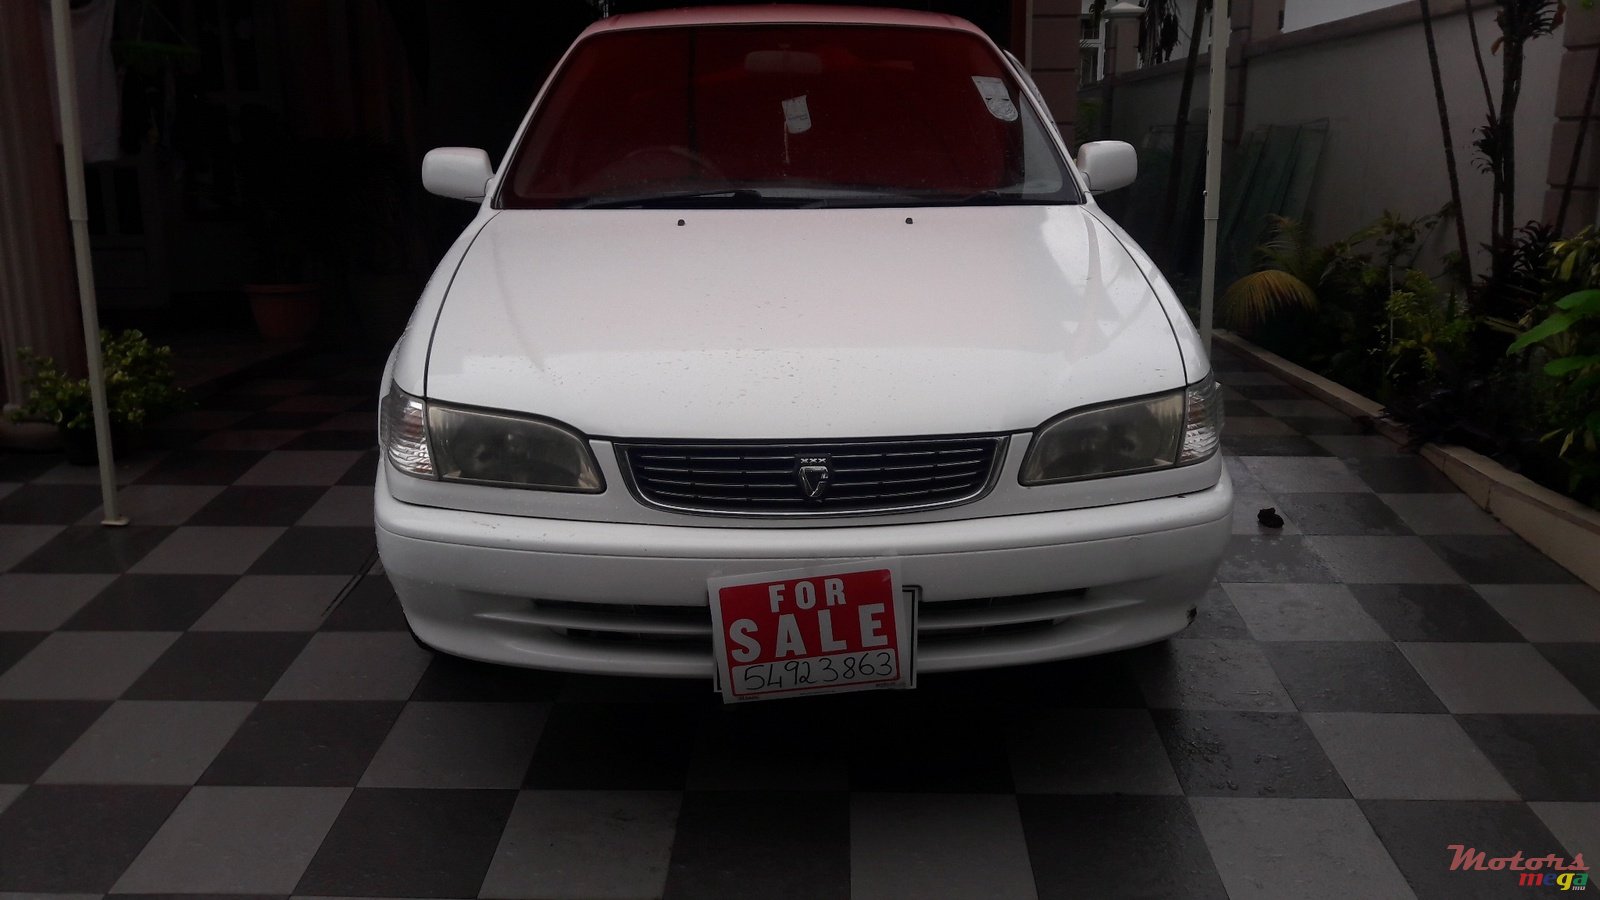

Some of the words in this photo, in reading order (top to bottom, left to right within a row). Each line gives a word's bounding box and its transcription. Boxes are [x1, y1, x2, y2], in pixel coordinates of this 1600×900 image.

[769, 578, 847, 613] FOR
[729, 603, 889, 663] SALE
[744, 652, 893, 691] 54923863
